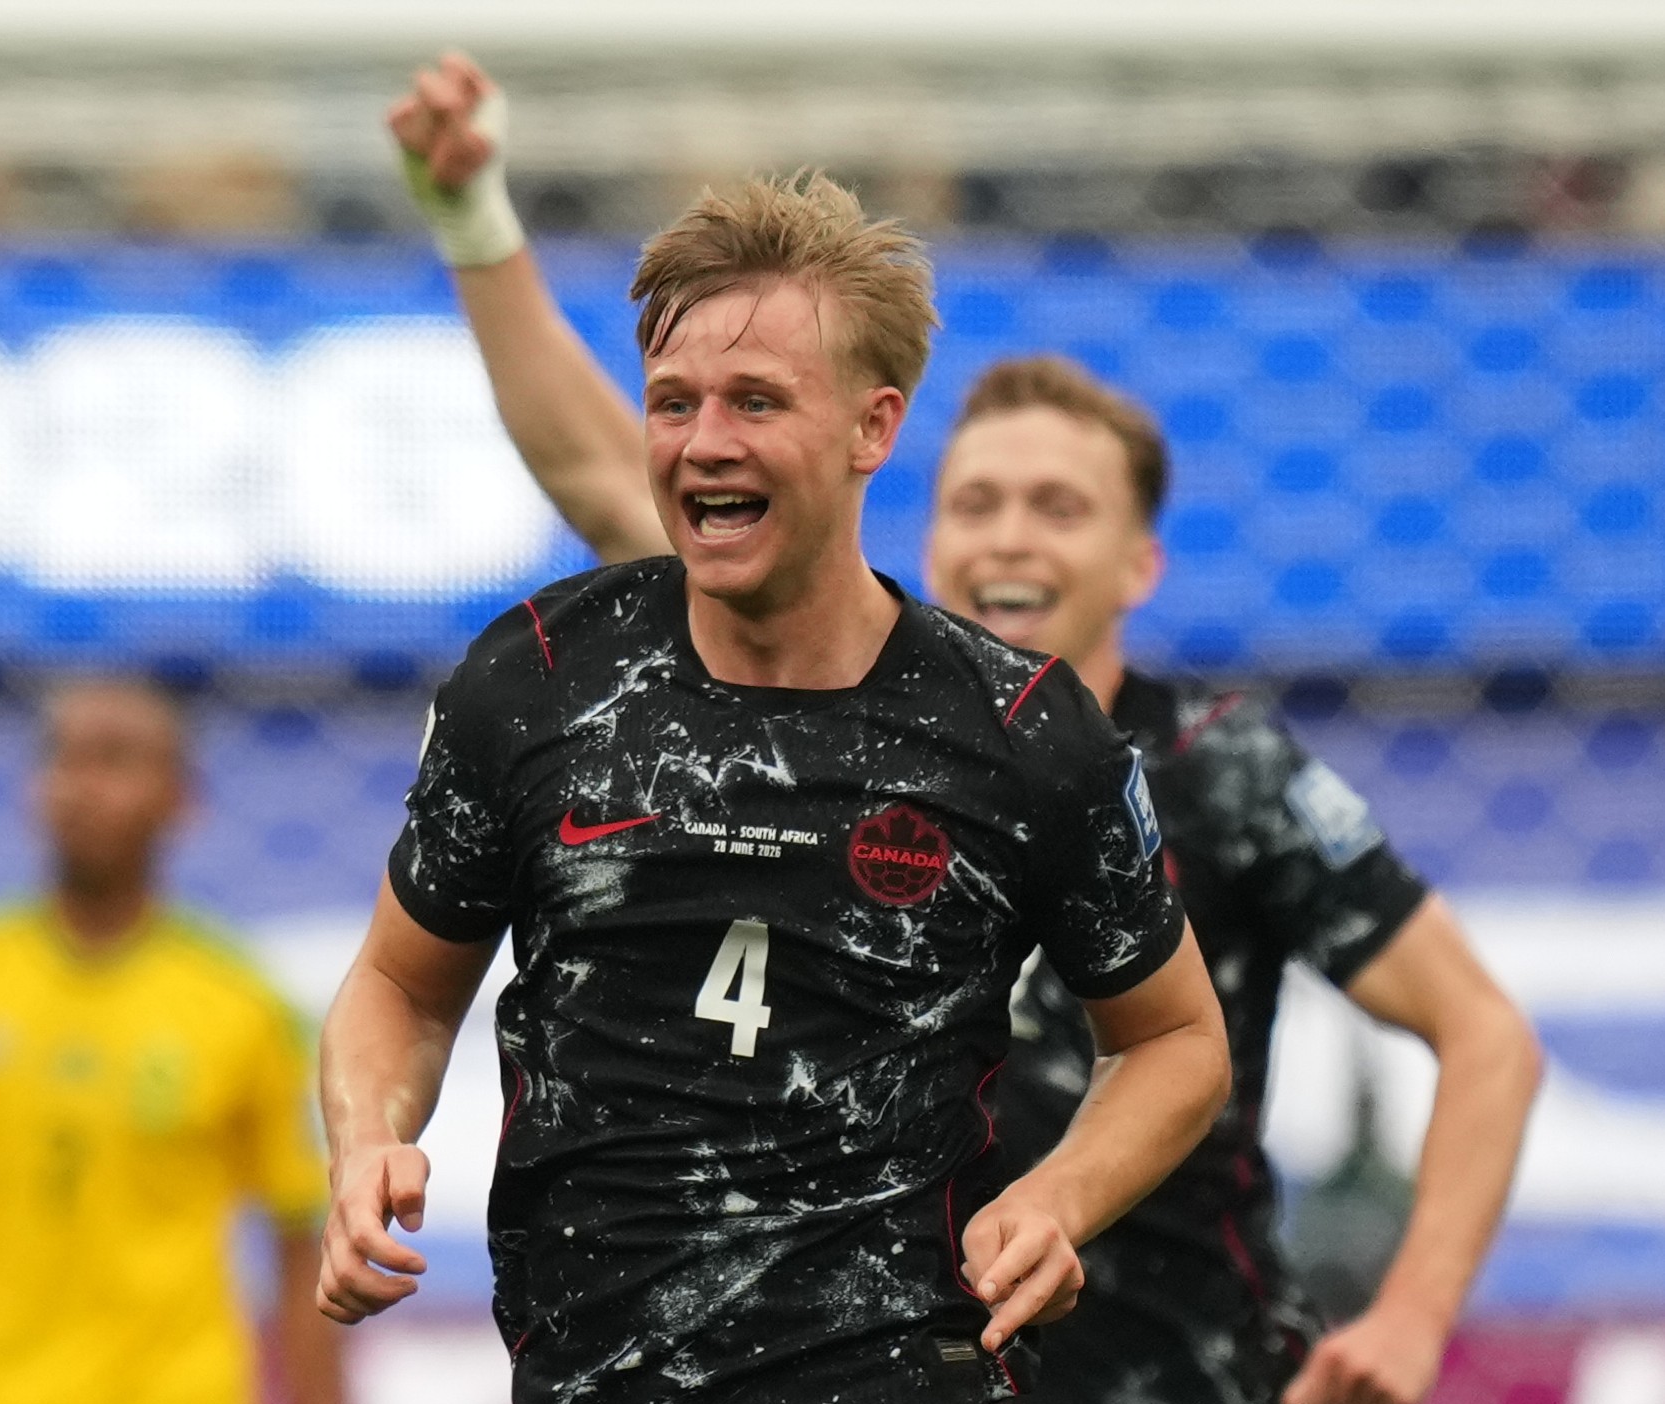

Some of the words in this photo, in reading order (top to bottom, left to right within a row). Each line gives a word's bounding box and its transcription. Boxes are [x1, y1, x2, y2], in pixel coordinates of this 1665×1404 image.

[684, 822, 727, 836] CANADA
[740, 826, 777, 841] SOUTH
[779, 829, 818, 845] AFRICA
[714, 840, 727, 853] 28
[729, 841, 755, 856] JUNE
[758, 844, 782, 858] 2026
[853, 844, 942, 869] CANADA
[694, 919, 771, 1058] 4
